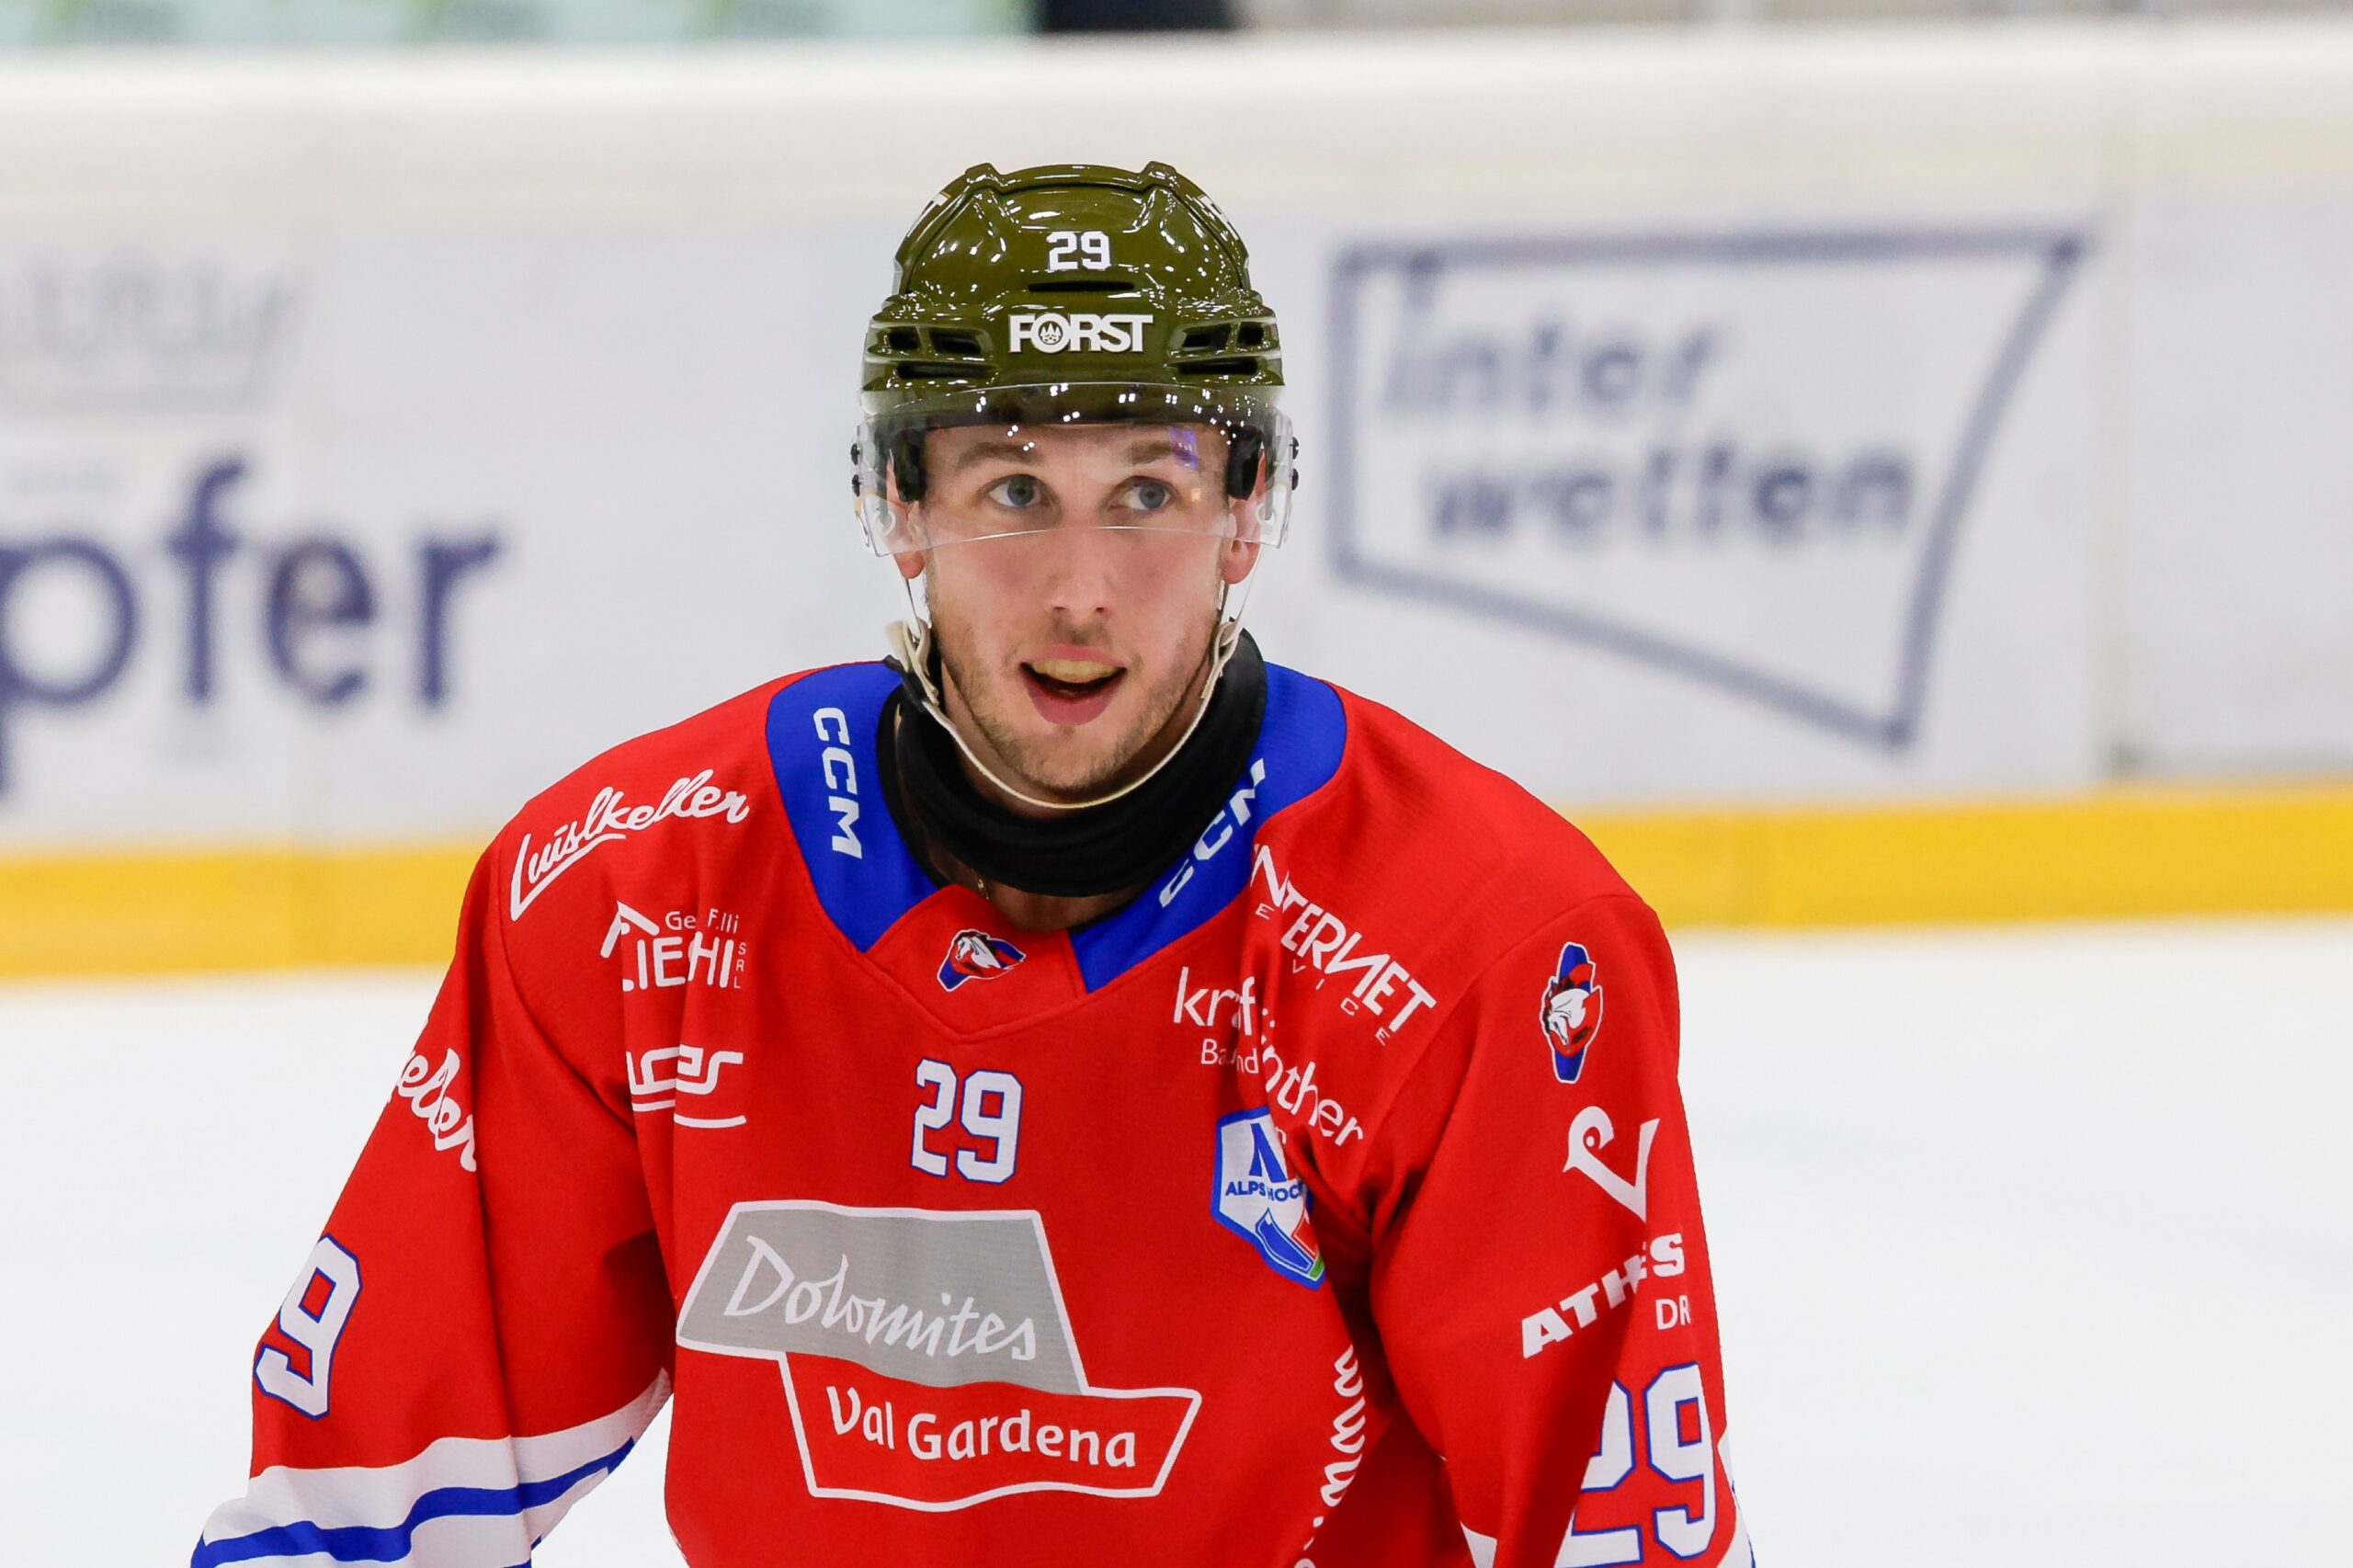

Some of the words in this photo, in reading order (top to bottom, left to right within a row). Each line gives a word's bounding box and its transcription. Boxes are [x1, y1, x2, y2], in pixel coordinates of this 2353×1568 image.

[1045, 231, 1112, 272] 29
[1008, 313, 1154, 354] FORST
[813, 707, 864, 860] CCM
[1158, 756, 1267, 909] CCM
[1250, 843, 1438, 1034] NTERNET
[911, 1058, 1023, 1185] 29
[1224, 1180, 1267, 1197] ALPS
[723, 1234, 1037, 1360] Dolomites
[1521, 1233, 1686, 1359] ATHS
[826, 1385, 896, 1449] Val
[907, 1409, 1137, 1468] Gardena
[1552, 1359, 1718, 1568] 29
